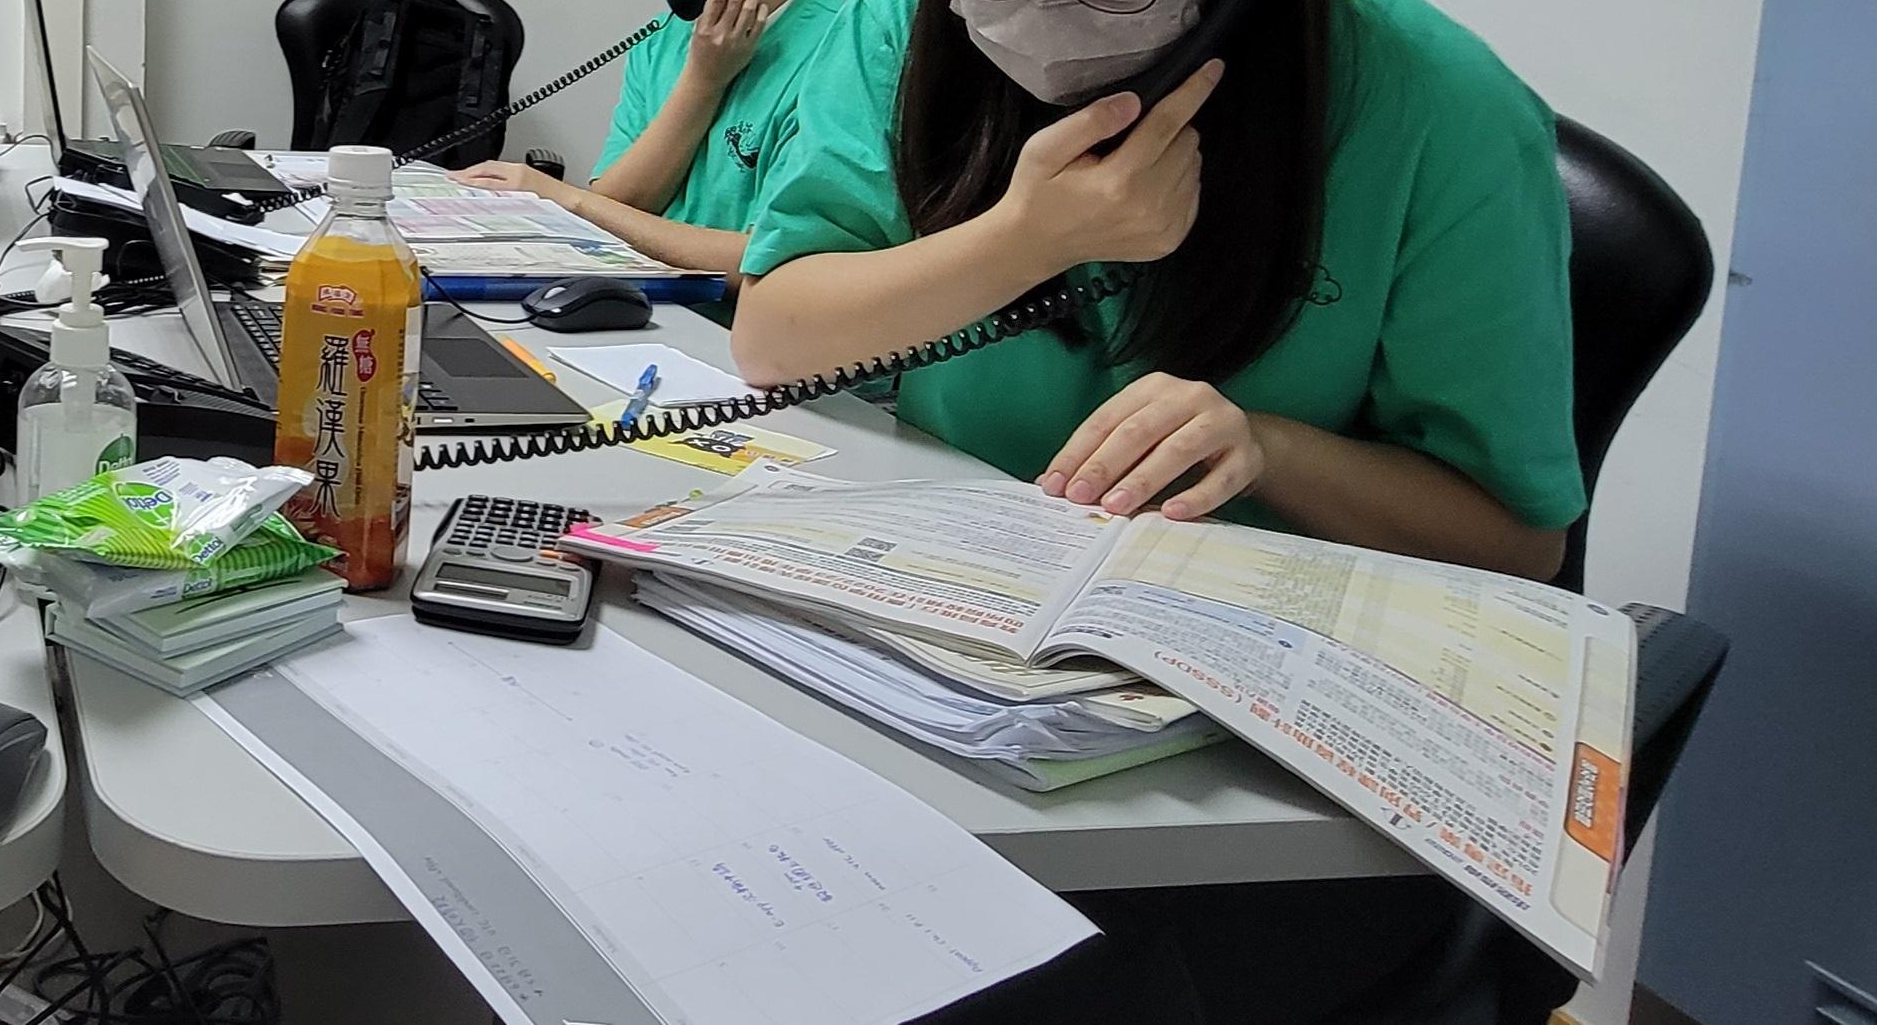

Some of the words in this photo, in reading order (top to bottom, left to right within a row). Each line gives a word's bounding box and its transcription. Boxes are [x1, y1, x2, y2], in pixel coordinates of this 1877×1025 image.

[309, 334, 350, 519] 羅漢果
[122, 490, 174, 511] Dettol
[183, 578, 214, 595] Dettol
